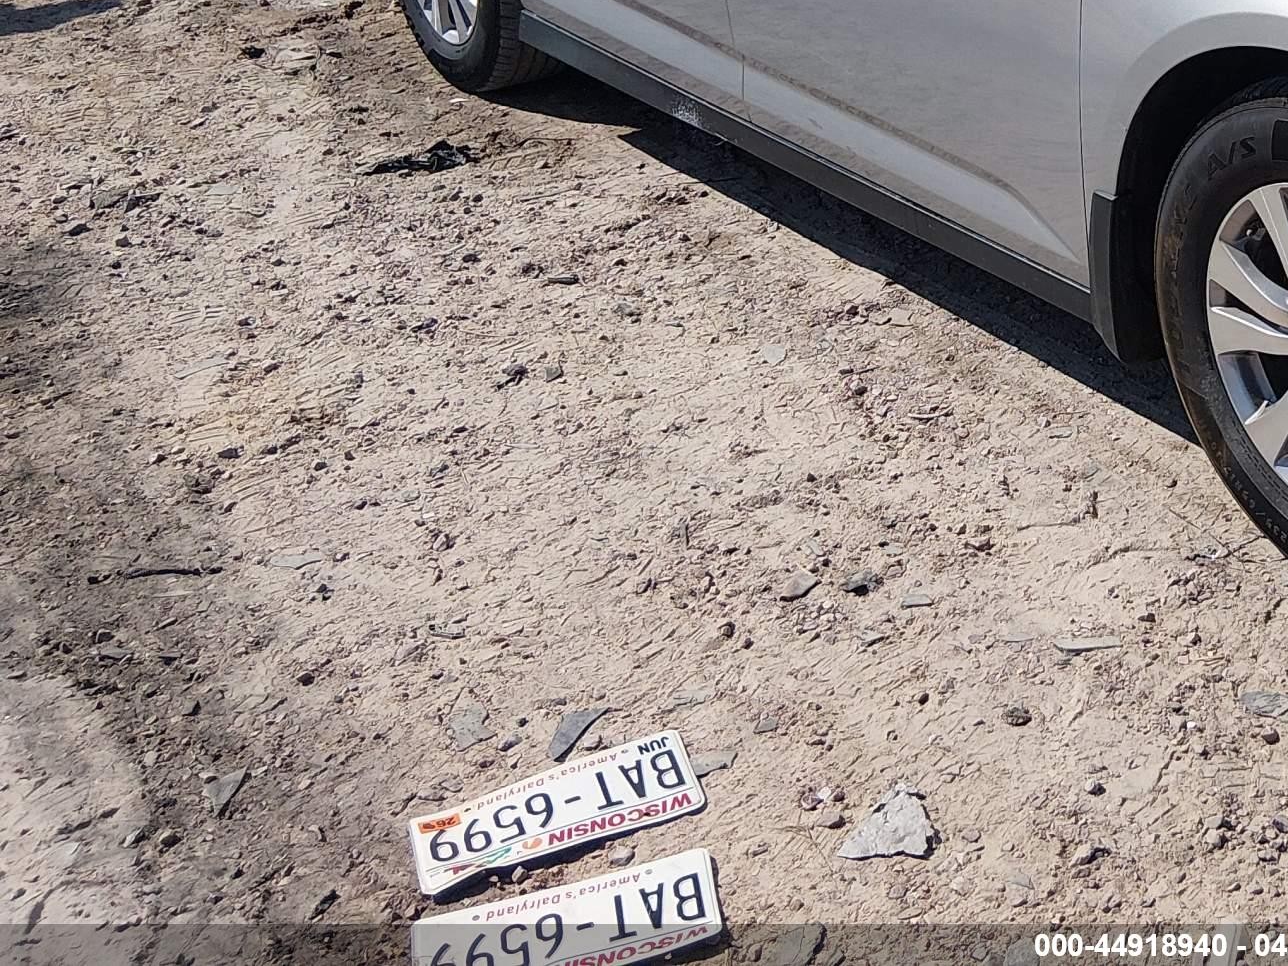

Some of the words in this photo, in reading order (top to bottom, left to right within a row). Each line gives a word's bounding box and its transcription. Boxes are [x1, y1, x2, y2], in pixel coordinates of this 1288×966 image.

[636, 735, 670, 756] JUN
[547, 752, 618, 781] America's
[429, 748, 687, 863] BAT-6599
[476, 778, 545, 811] Dairyland
[547, 793, 693, 846] WISCONSIN
[565, 872, 641, 900] America's
[485, 893, 561, 921] Dairyland
